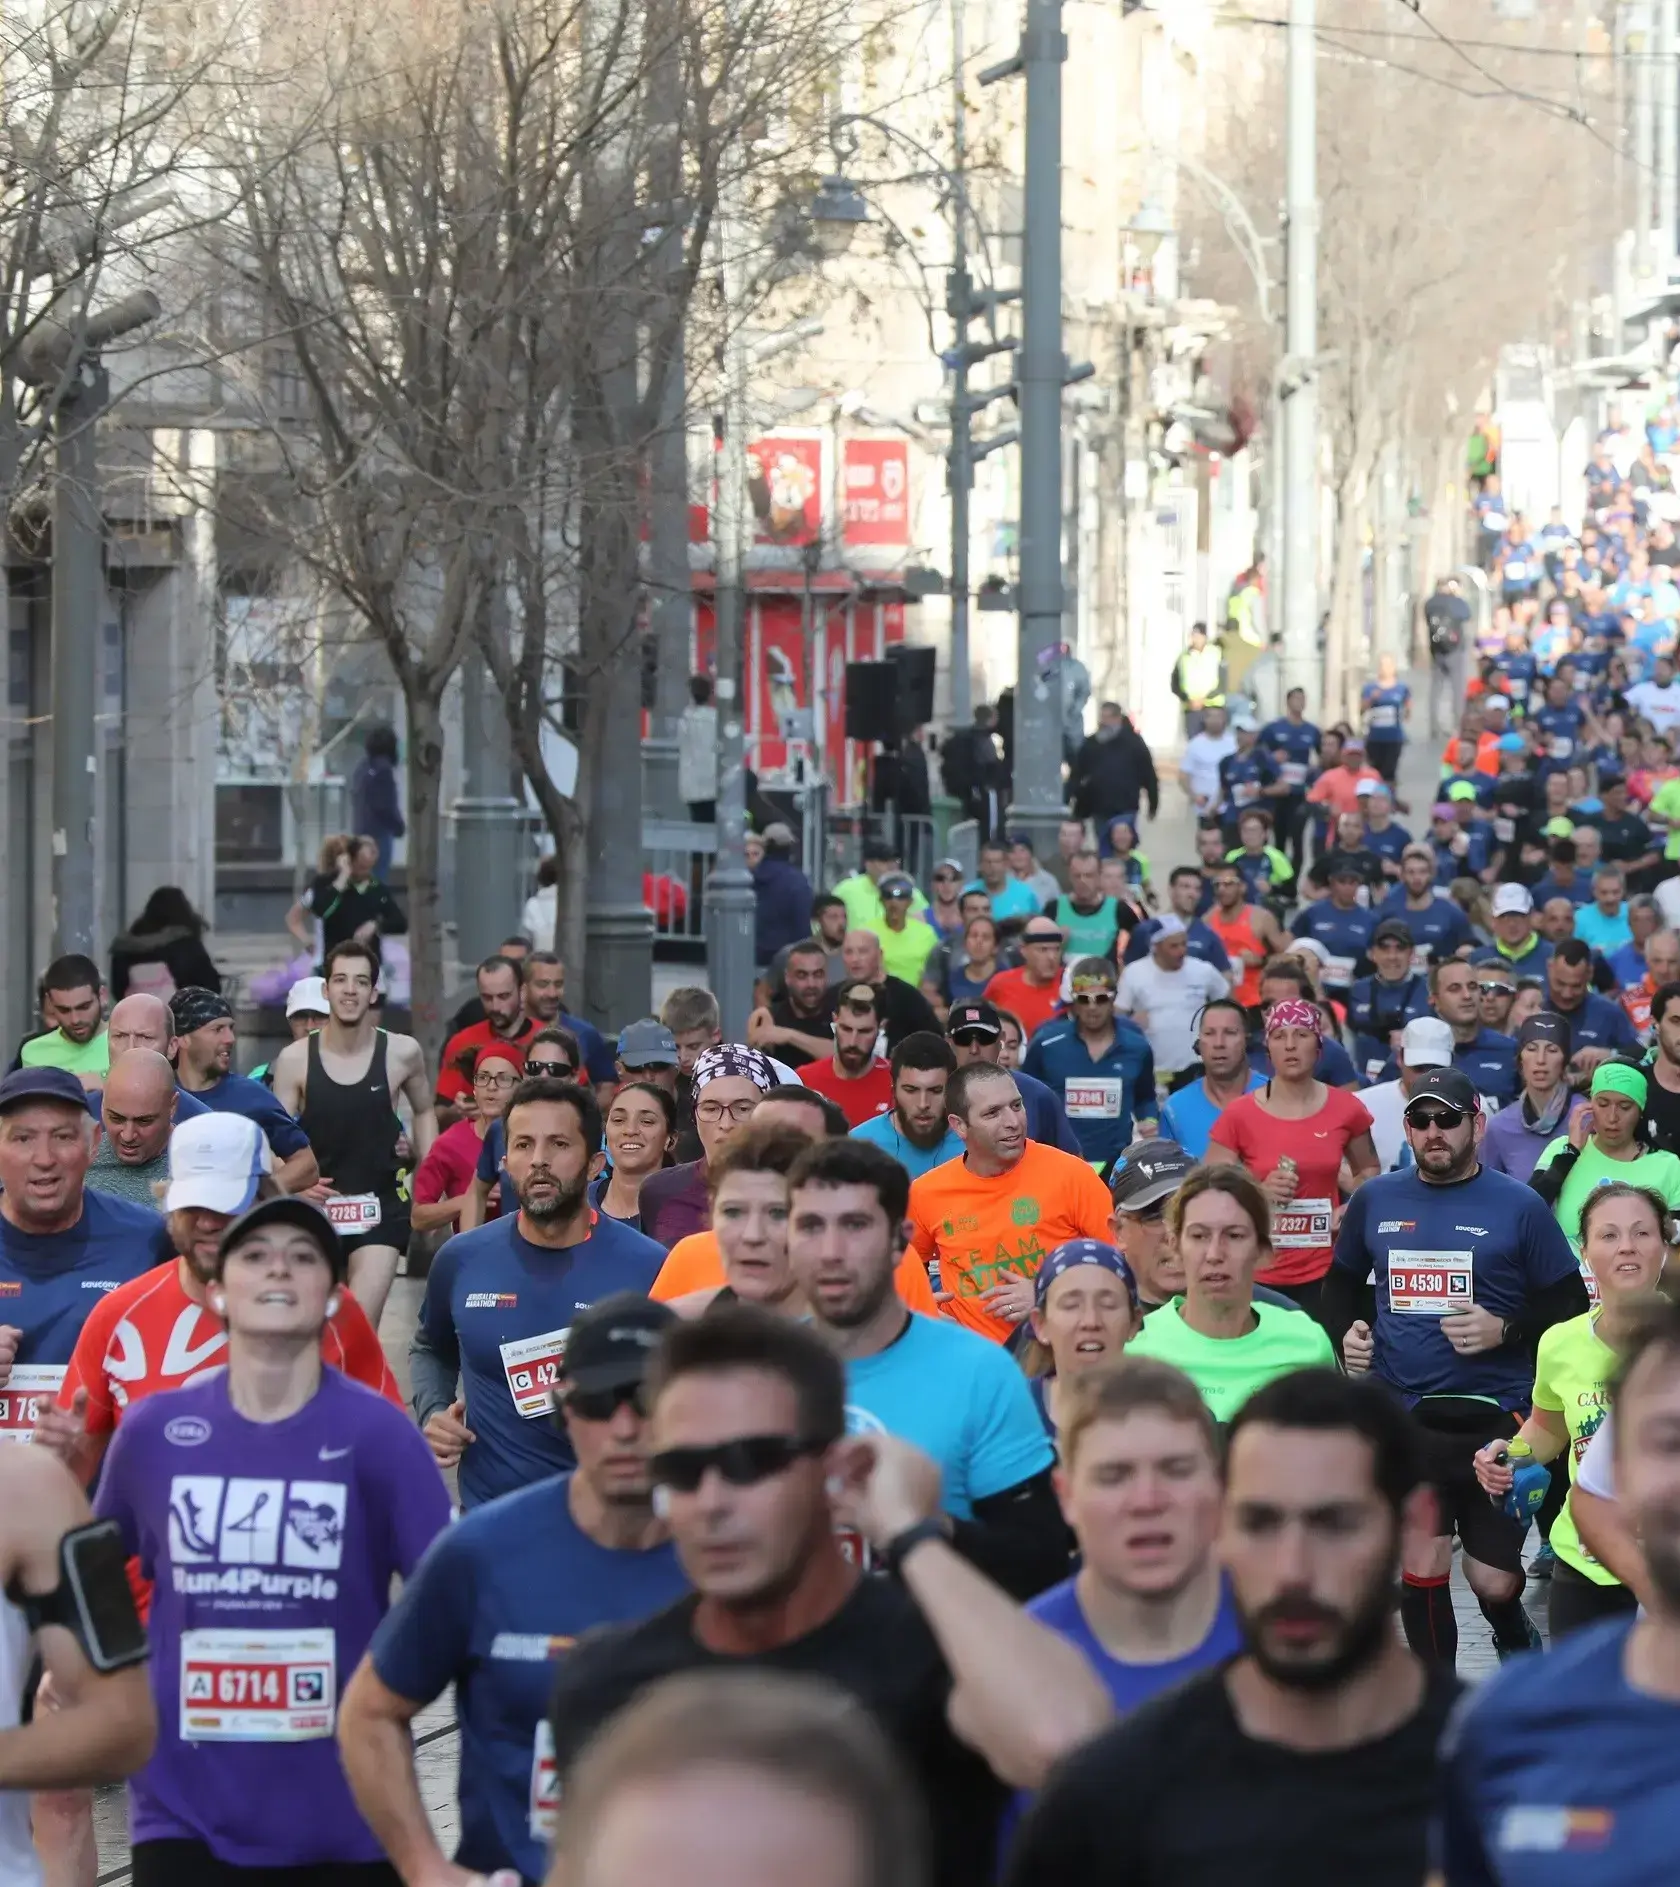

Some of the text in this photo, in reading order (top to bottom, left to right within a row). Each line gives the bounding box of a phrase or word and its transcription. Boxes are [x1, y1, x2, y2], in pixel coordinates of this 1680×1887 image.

[331, 1205, 357, 1220] 2726
[1280, 1217, 1308, 1231] 2327
[81, 1281, 120, 1291] saucony
[1394, 1274, 1443, 1292] B 4530
[516, 1374, 529, 1388] C
[171, 1565, 339, 1601] Run4Purple
[192, 1668, 280, 1703] A 6714
